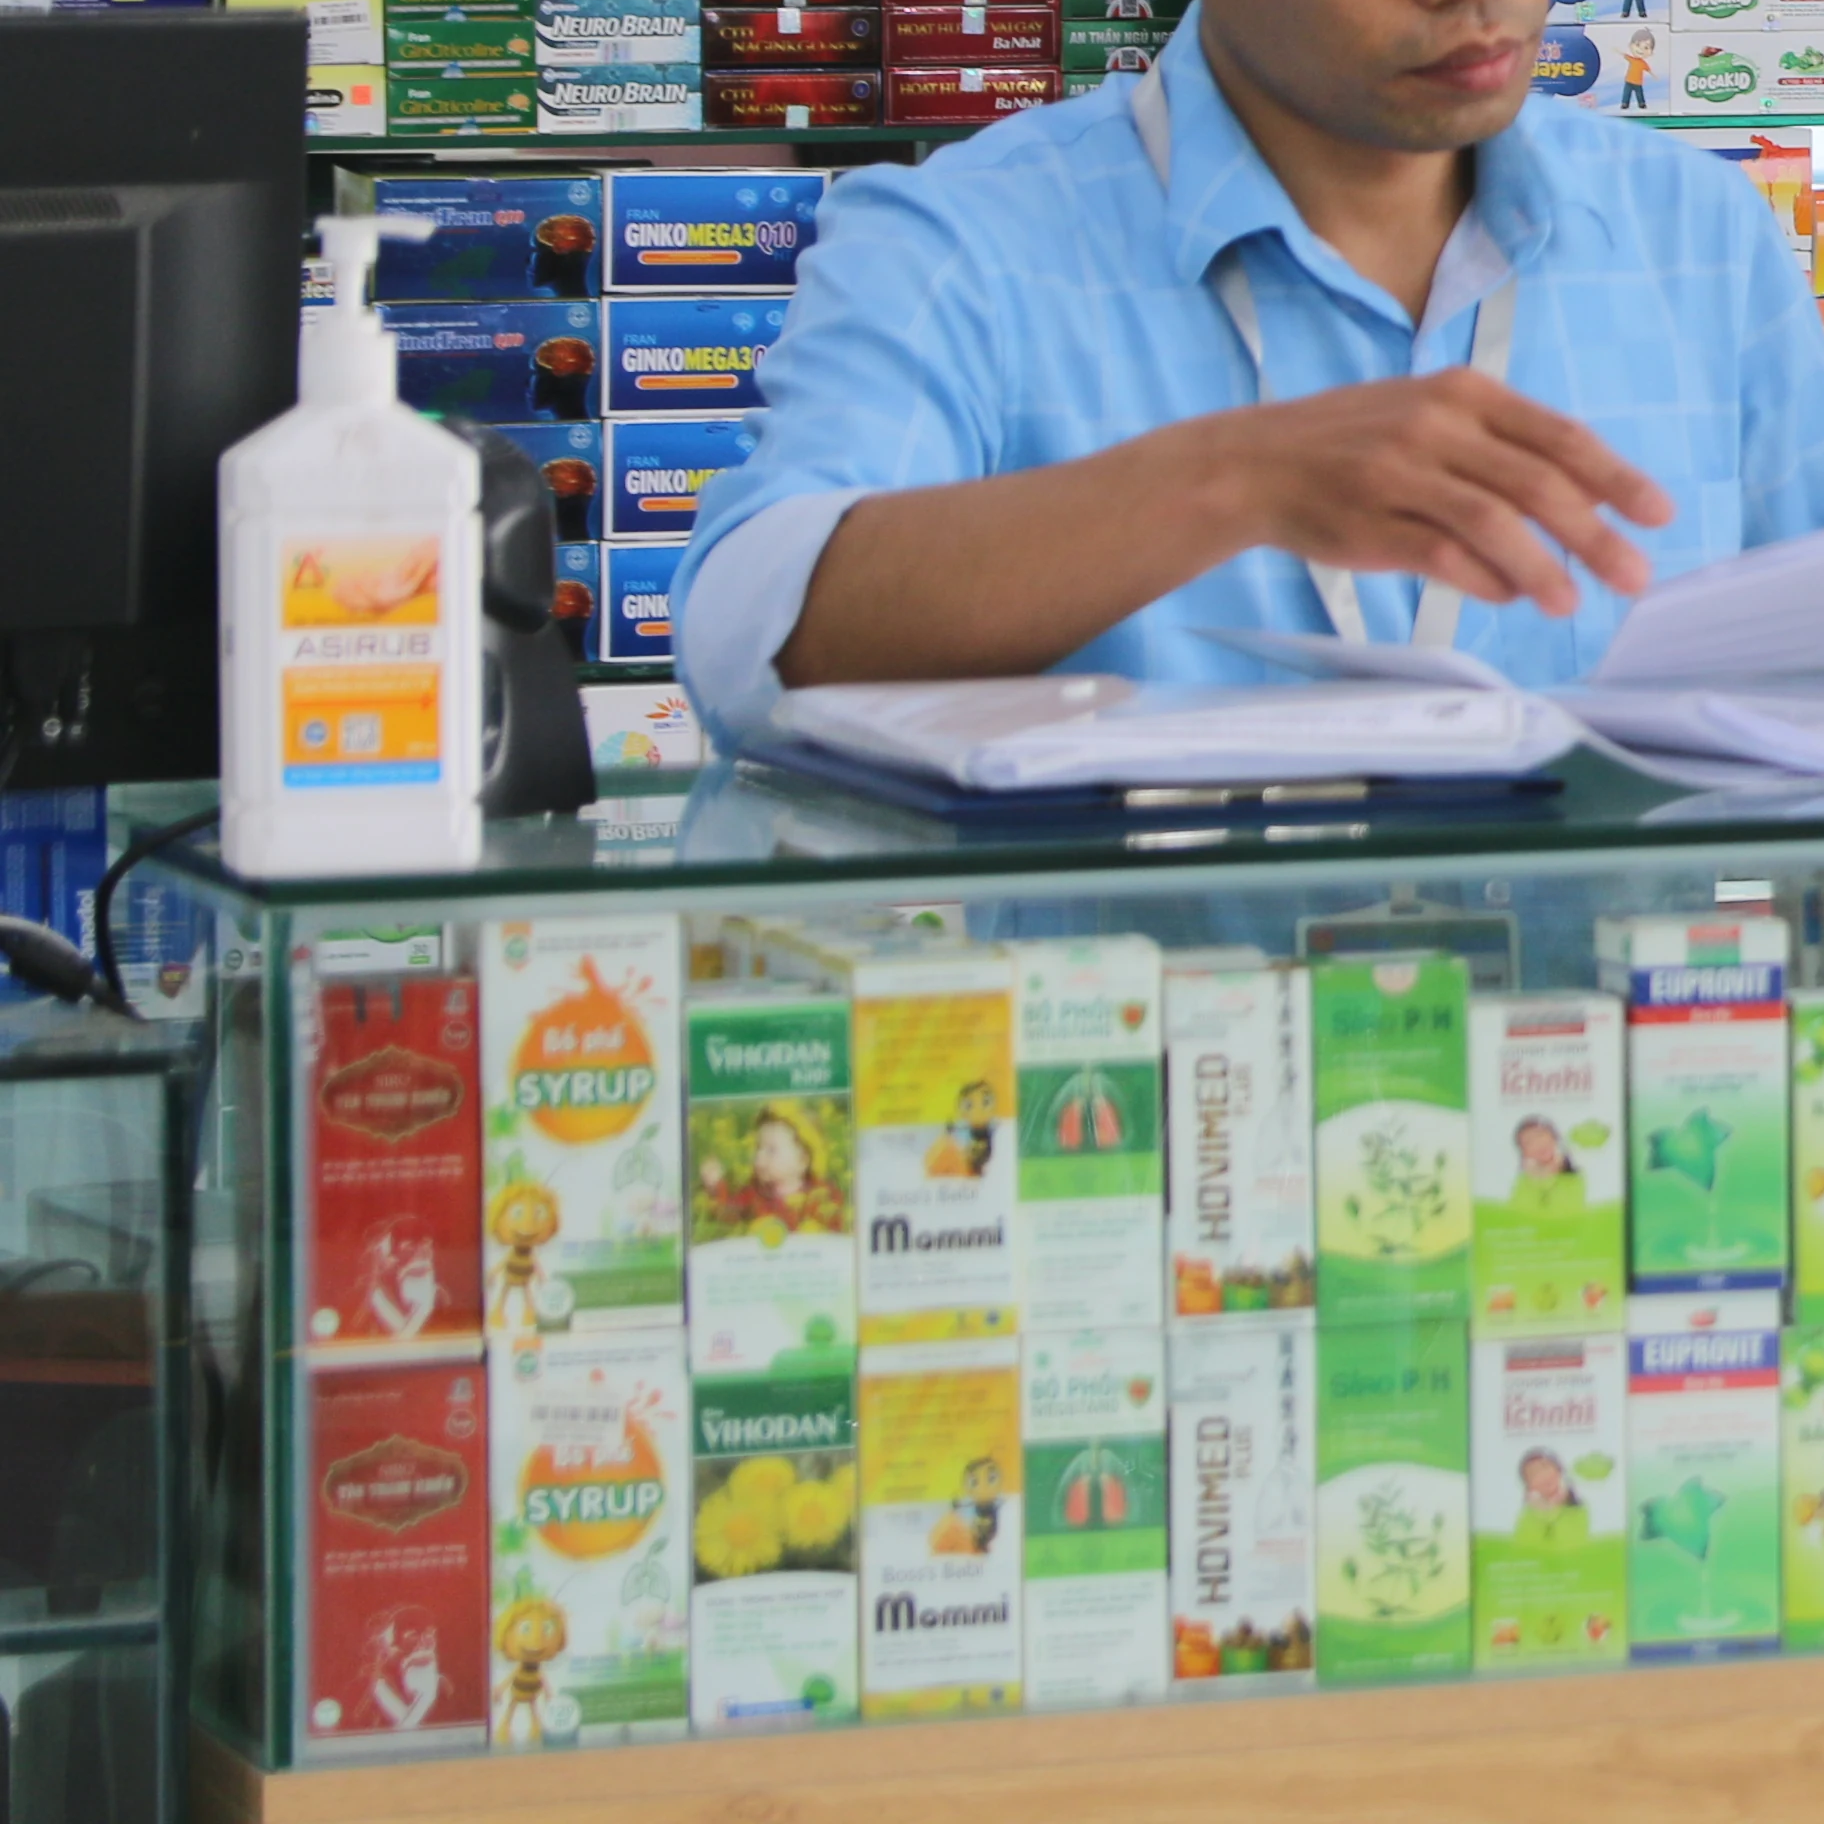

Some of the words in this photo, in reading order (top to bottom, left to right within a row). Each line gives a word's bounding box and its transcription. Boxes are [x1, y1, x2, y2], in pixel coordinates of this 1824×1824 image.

[992, 36, 1010, 49] Ba
[1069, 31, 1088, 44] AN
[625, 210, 660, 221] FRAN
[626, 222, 755, 247] GINKOMEGA3
[755, 221, 797, 255] Q10
[622, 346, 752, 372] GINKOMEGA3
[295, 635, 430, 658] ASIRUB
[526, 1480, 660, 1518] SYRUP
[1196, 1416, 1232, 1605] HOVIMED
[876, 1593, 1008, 1633] Mommi
